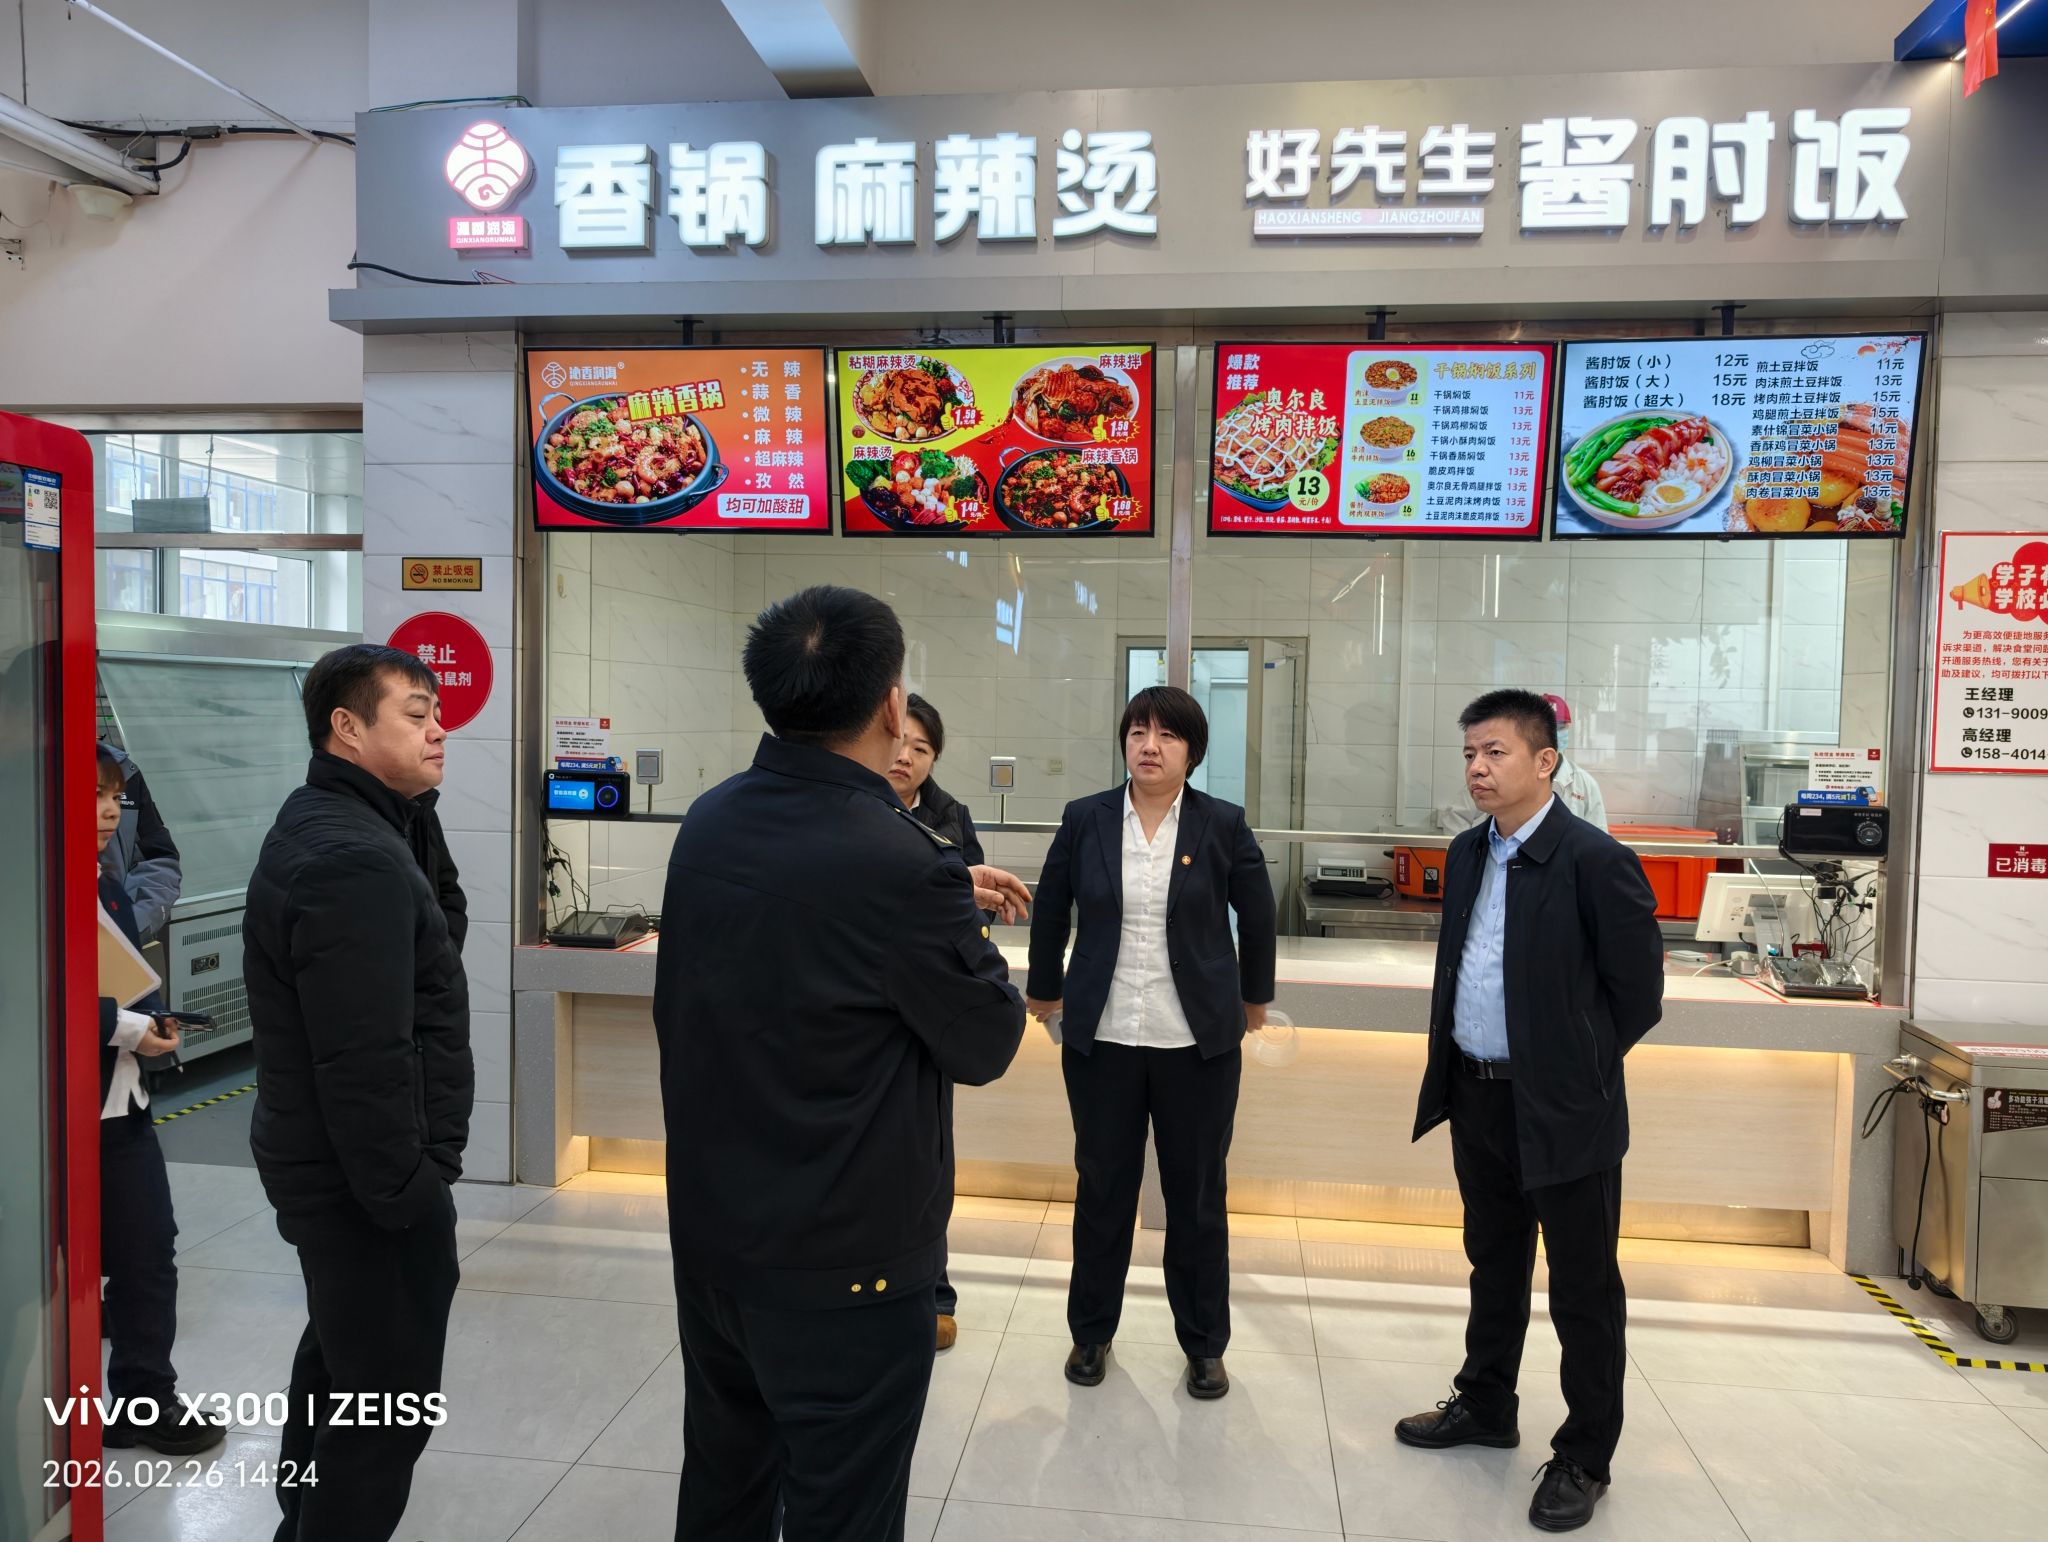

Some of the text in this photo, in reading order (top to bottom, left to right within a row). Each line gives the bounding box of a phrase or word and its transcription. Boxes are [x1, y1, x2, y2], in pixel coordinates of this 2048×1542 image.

[1245, 107, 1912, 231] 好先生 酱肘饭
[555, 128, 1158, 250] 香锅 麻辣烫
[1258, 210, 1480, 225] HAOXIANSHENG JIANGZHOUFAN
[849, 354, 917, 370] 粘糊麻辣烫
[1099, 354, 1142, 369] 麻辣拌
[1227, 354, 1260, 370] 爆款
[1714, 353, 1749, 368] 12元
[1756, 358, 1905, 373] 煎土豆拌饭 11元
[1433, 362, 1537, 380] 干锅焖饭系列
[1226, 374, 1259, 390] 推荐
[1713, 373, 1747, 388] 15元
[1755, 374, 1902, 388] 肉沫煎土豆拌饭 13元
[627, 380, 725, 421] 麻辣香锅
[1265, 387, 1327, 411] 奥尔良
[1434, 390, 1534, 400] 干锅焖饭 11元
[1711, 392, 1746, 407] 18元
[1753, 390, 1901, 404] 烤肉煎土豆拌饭 15元
[1433, 405, 1533, 415] 干锅鸡排焖饭 13元
[1752, 406, 1899, 420] 鸡腿煎土豆拌饭 15元
[1251, 415, 1340, 437] 烤肉拌饭
[1432, 421, 1532, 431] 干锅鸡柳焖饭 13元
[1751, 422, 1898, 436] 素什锦冒菜小锅 11元
[1431, 436, 1531, 446] 干锅小酥肉焖饭 13元
[1750, 438, 1896, 452] 香酥鸡冒菜小锅 13元
[755, 451, 804, 467] 超麻辣
[853, 446, 893, 460] 麻辣烫
[1081, 448, 1138, 464] 麻辣香锅
[1406, 449, 1415, 457] 16
[1430, 451, 1530, 461] 干锅香肠焖饭 13元
[1748, 454, 1894, 467] 鸡柳冒菜小锅 13元
[1428, 466, 1529, 476] 脆皮鸡拌饭 13元
[1747, 470, 1893, 483] 酥肉冒菜小锅 13元
[1297, 477, 1320, 496] 13
[1507, 482, 1527, 492] 13元
[1746, 485, 1891, 498] 肉卷冒菜小锅 13元
[725, 498, 804, 514] 均可加酸甜
[1298, 497, 1319, 506] 元/份
[1505, 497, 1526, 507] 13元
[1403, 505, 1412, 513] 16
[1504, 512, 1525, 522] 13元
[432, 564, 474, 576] 禁止吸烟
[417, 644, 457, 664] 禁止
[1964, 687, 2014, 701] 王经理
[1976, 707, 2048, 719] 131-9009
[1962, 728, 2011, 742] 高经理
[1996, 857, 2047, 873] 已消毒
